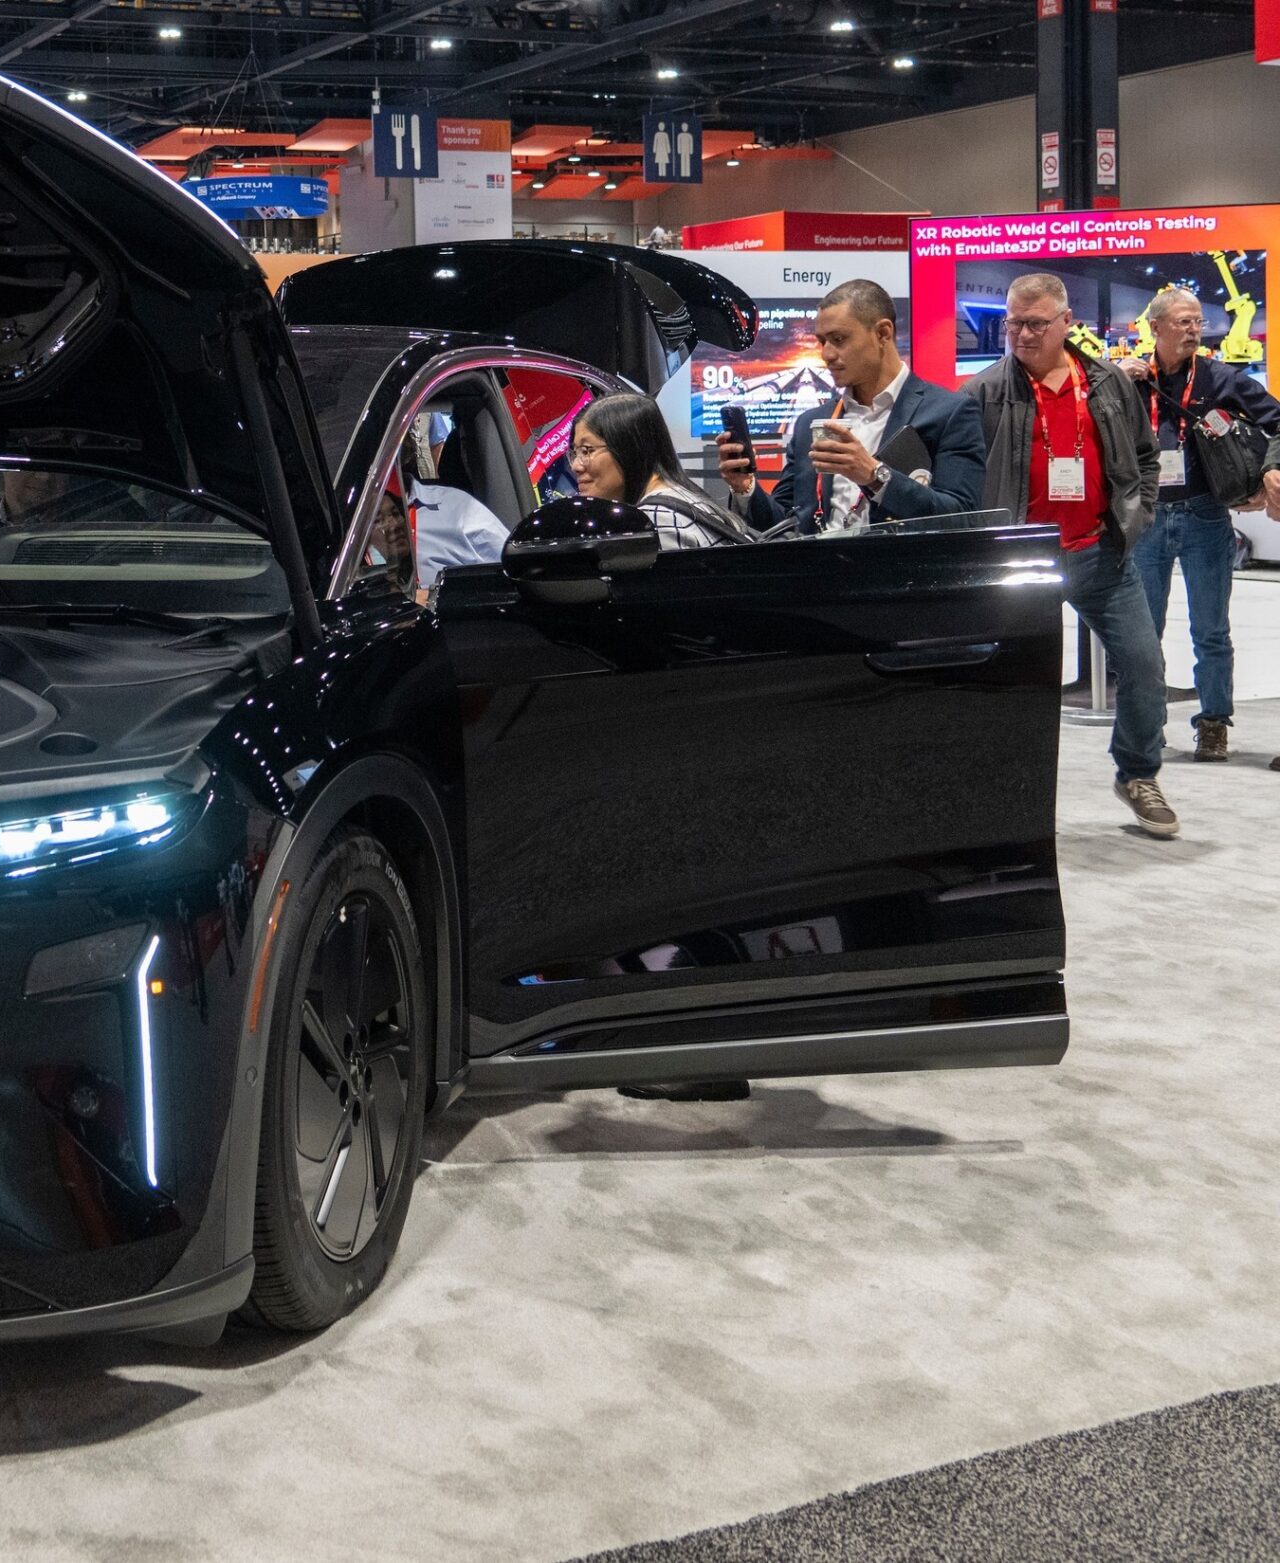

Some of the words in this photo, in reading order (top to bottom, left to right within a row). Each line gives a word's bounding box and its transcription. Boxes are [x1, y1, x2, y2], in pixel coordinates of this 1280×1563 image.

[441, 125, 465, 135] Thank
[467, 127, 481, 137] you
[443, 137, 480, 146] sponsors
[209, 182, 273, 191] SPECTRUM
[916, 227, 937, 241] XR
[941, 223, 1002, 240] Robotic
[1004, 221, 1047, 237] Weld
[1050, 219, 1080, 234] Cell
[1083, 217, 1152, 233] Controls
[1154, 215, 1217, 232] Testing
[734, 240, 744, 250] Our
[744, 239, 764, 249] Future
[814, 235, 862, 247] Engineering
[862, 235, 876, 245] Our
[877, 235, 903, 245] Future
[916, 243, 951, 257] with
[1048, 236, 1103, 254] Digital
[1106, 235, 1145, 250] Twin
[783, 267, 832, 287] Energy
[956, 281, 1009, 297] ENTRA
[770, 308, 805, 320] pipeline
[759, 320, 784, 331] peline
